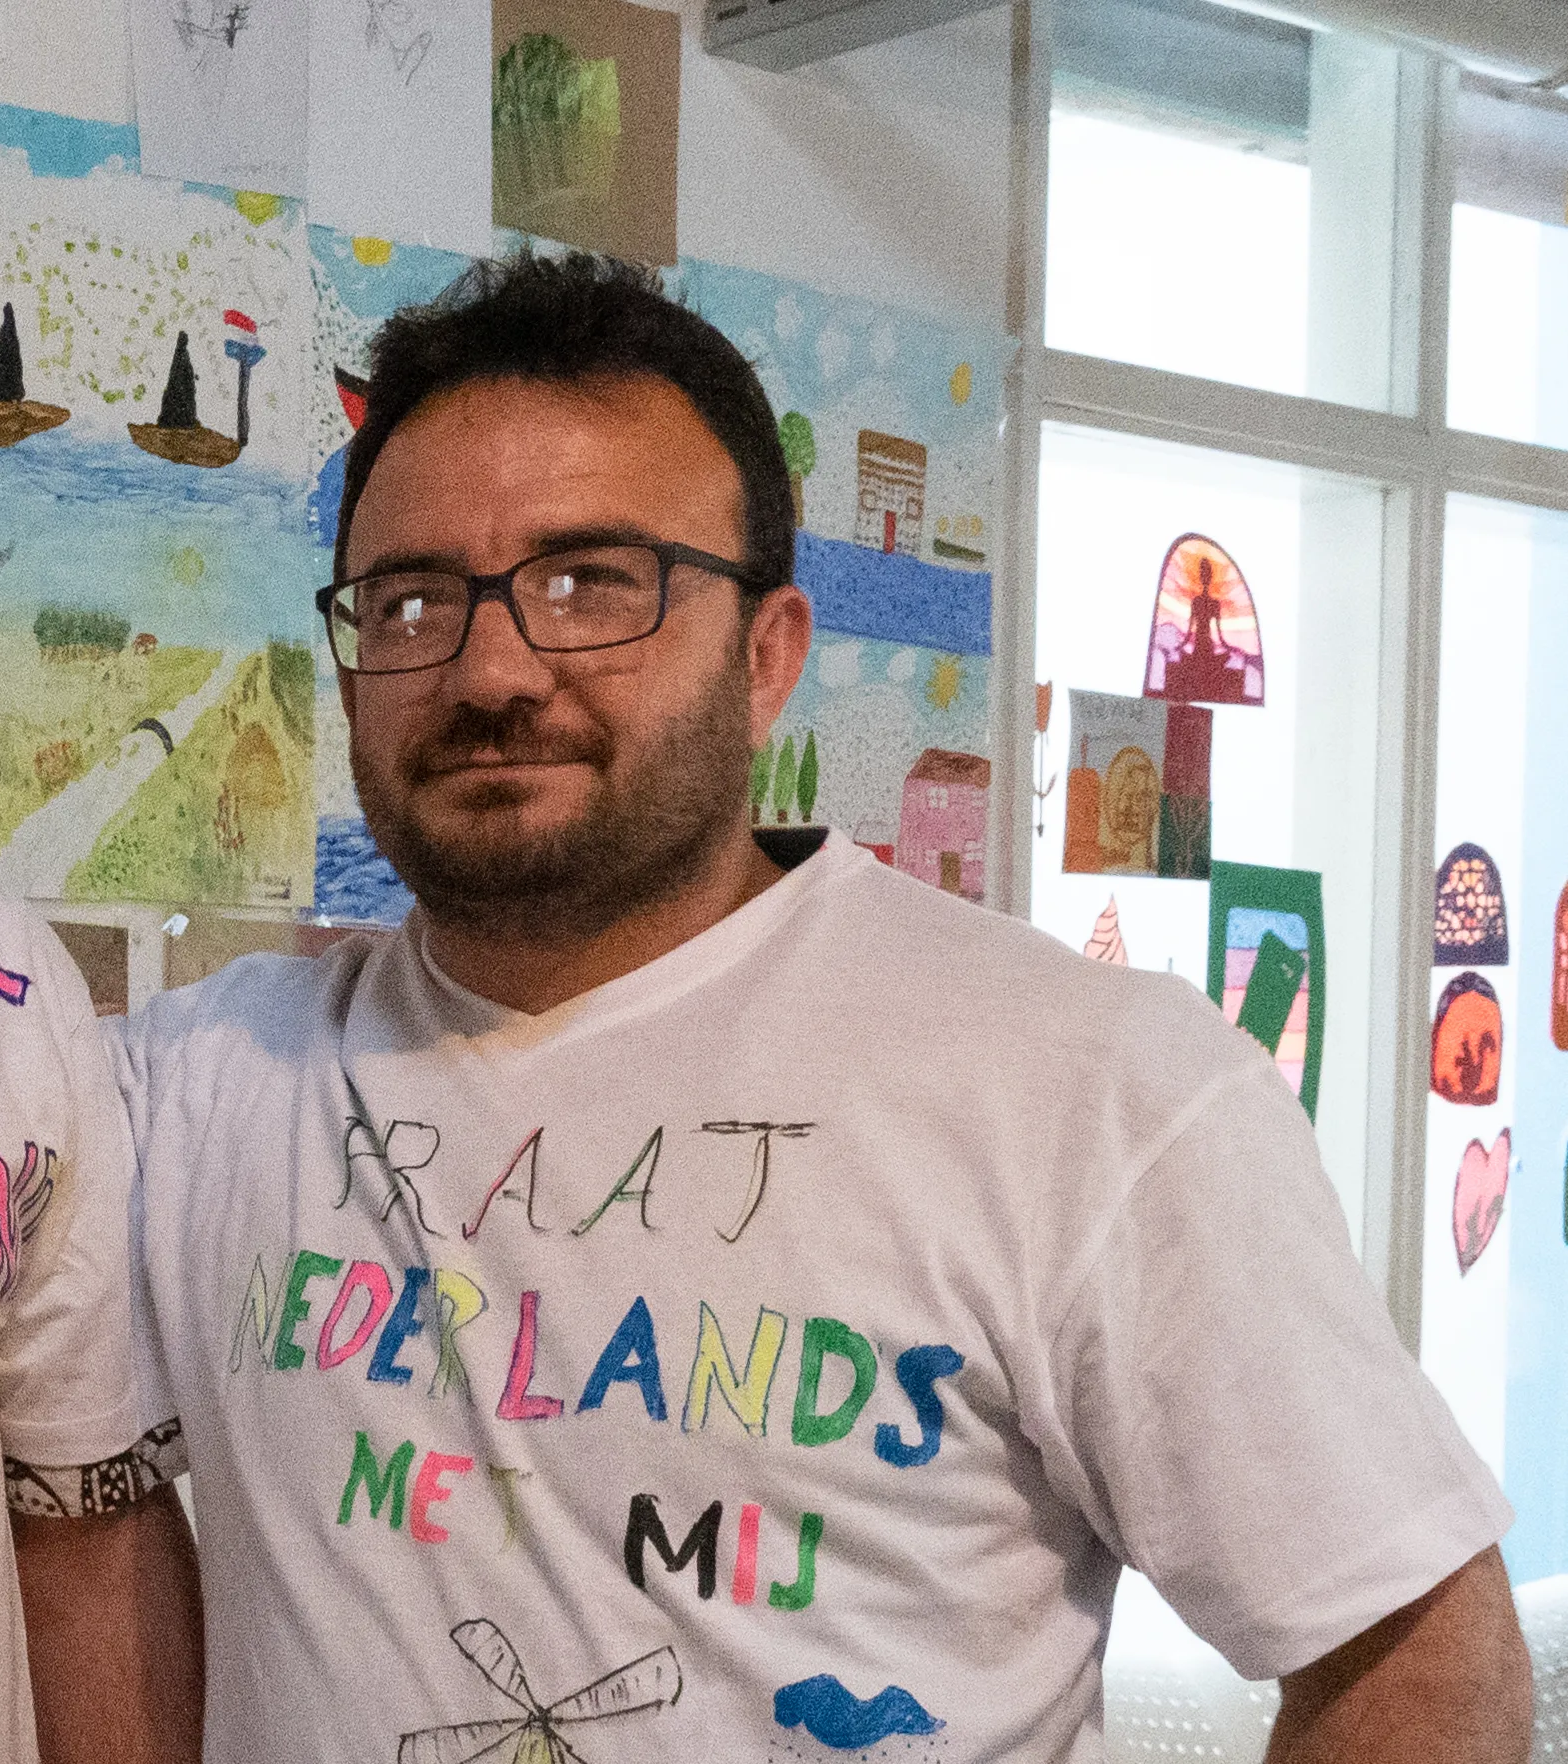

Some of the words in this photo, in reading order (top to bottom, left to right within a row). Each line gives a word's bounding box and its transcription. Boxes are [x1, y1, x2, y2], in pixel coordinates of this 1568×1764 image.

[228, 1249, 966, 1470] NEDERLANDS
[336, 1430, 533, 1552] MET
[622, 1492, 827, 1614] MIJ
